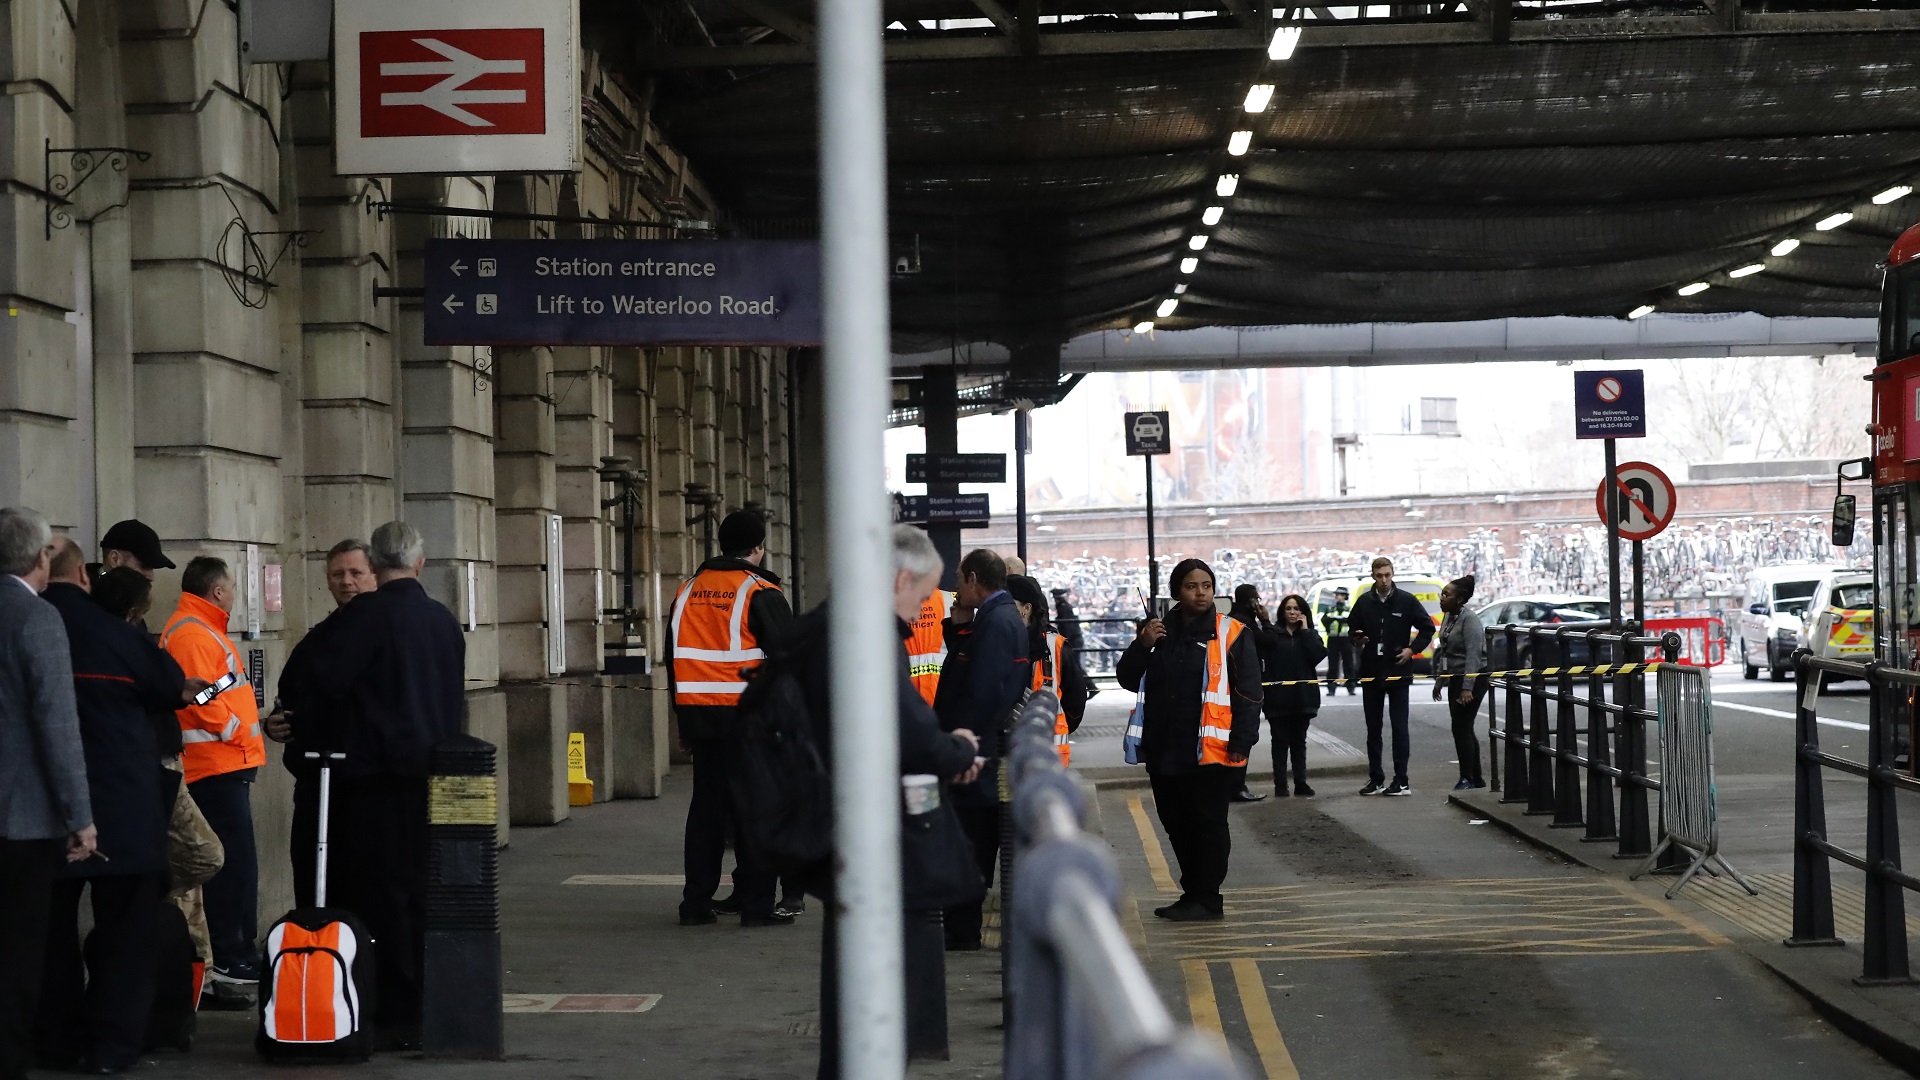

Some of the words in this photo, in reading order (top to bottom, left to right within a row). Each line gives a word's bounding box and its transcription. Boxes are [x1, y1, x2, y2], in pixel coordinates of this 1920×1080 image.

[534, 256, 613, 277] Station
[620, 258, 716, 277] entrance
[536, 295, 575, 315] Lift
[582, 296, 604, 315] to
[612, 295, 712, 315] Waterloo
[719, 295, 775, 315] Road
[929, 497, 953, 505] Station
[929, 509, 953, 517] Station
[691, 590, 735, 599] WATERLOO
